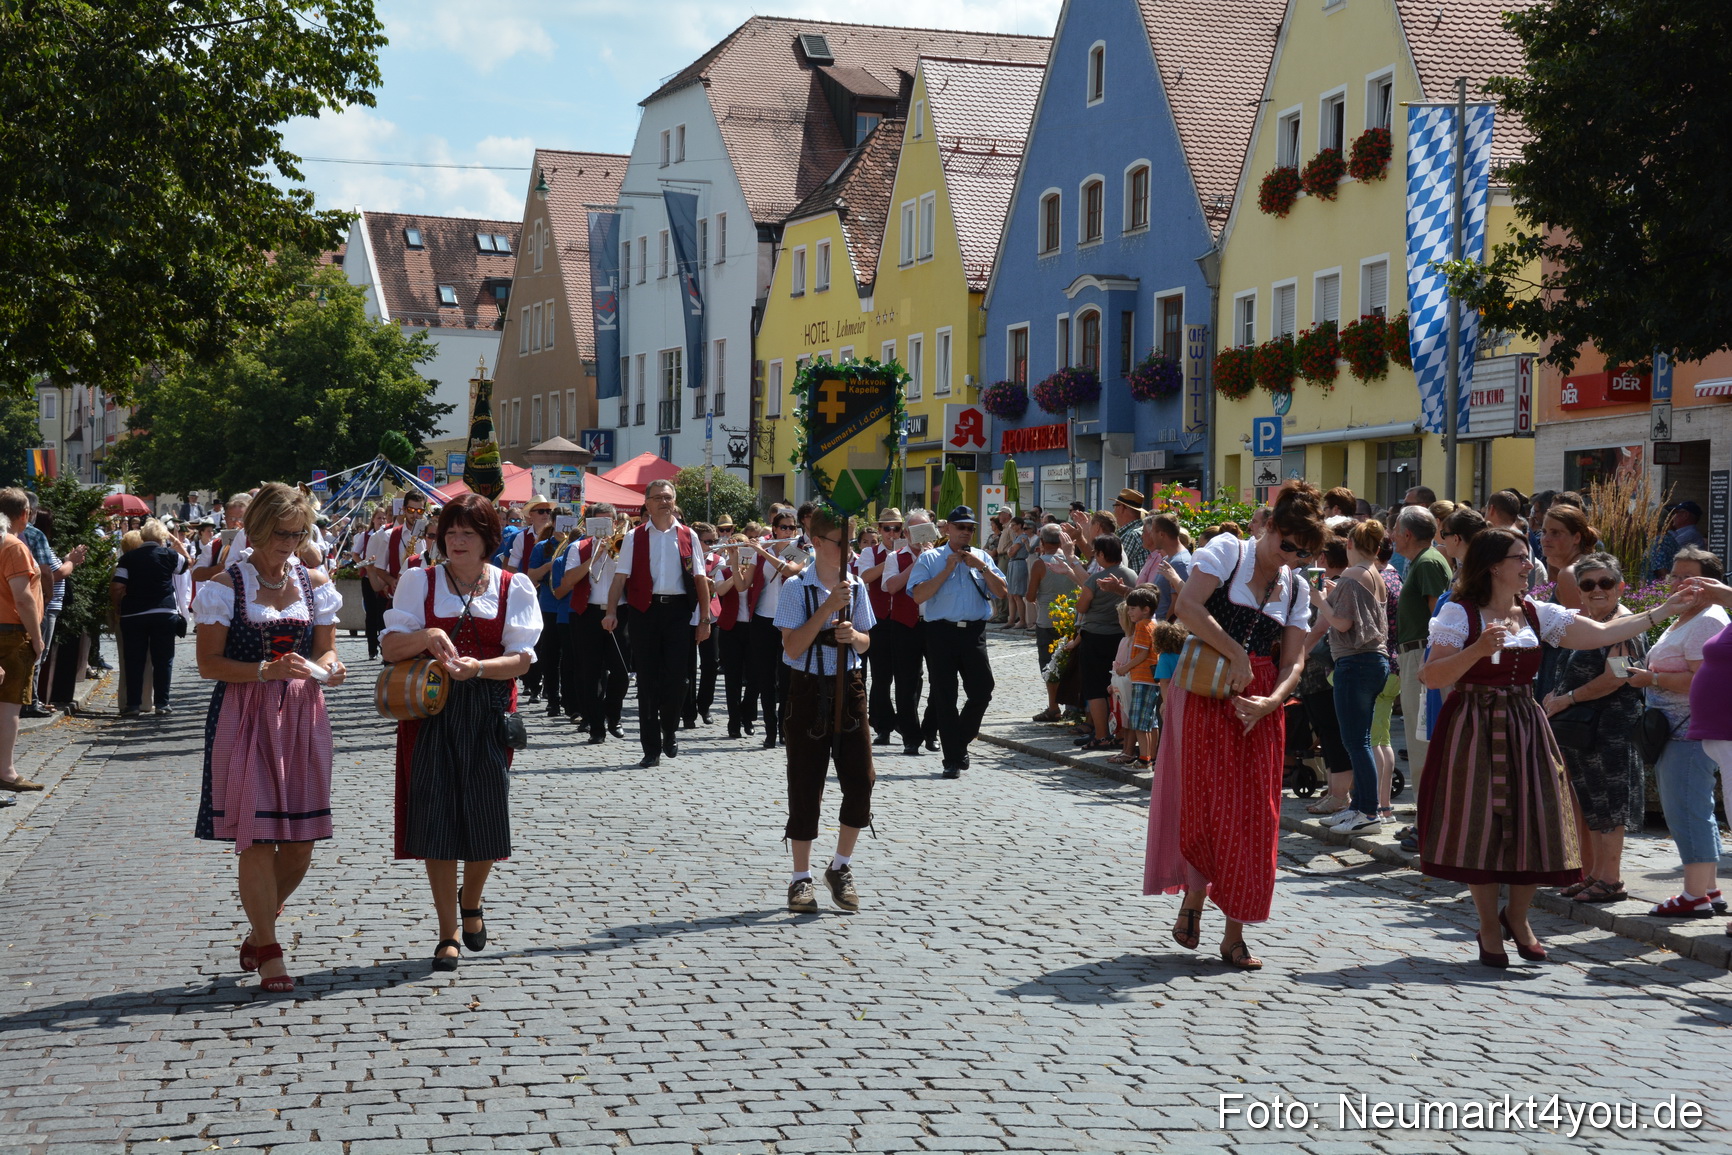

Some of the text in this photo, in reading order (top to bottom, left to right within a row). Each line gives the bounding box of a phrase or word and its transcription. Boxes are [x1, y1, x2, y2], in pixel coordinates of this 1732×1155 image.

[804, 320, 829, 346] HOTEL
[1188, 326, 1206, 342] CAFÉ
[848, 386, 880, 394] Kapelle
[1189, 345, 1204, 423] WITTL
[1486, 388, 1504, 405] KINO
[1519, 358, 1530, 430] KINO
[1561, 387, 1579, 404] DER
[1612, 376, 1641, 391] DER
[820, 424, 857, 452] Neumarkt
[1000, 424, 1066, 453] APOTHEKE
[1259, 421, 1276, 453] P
